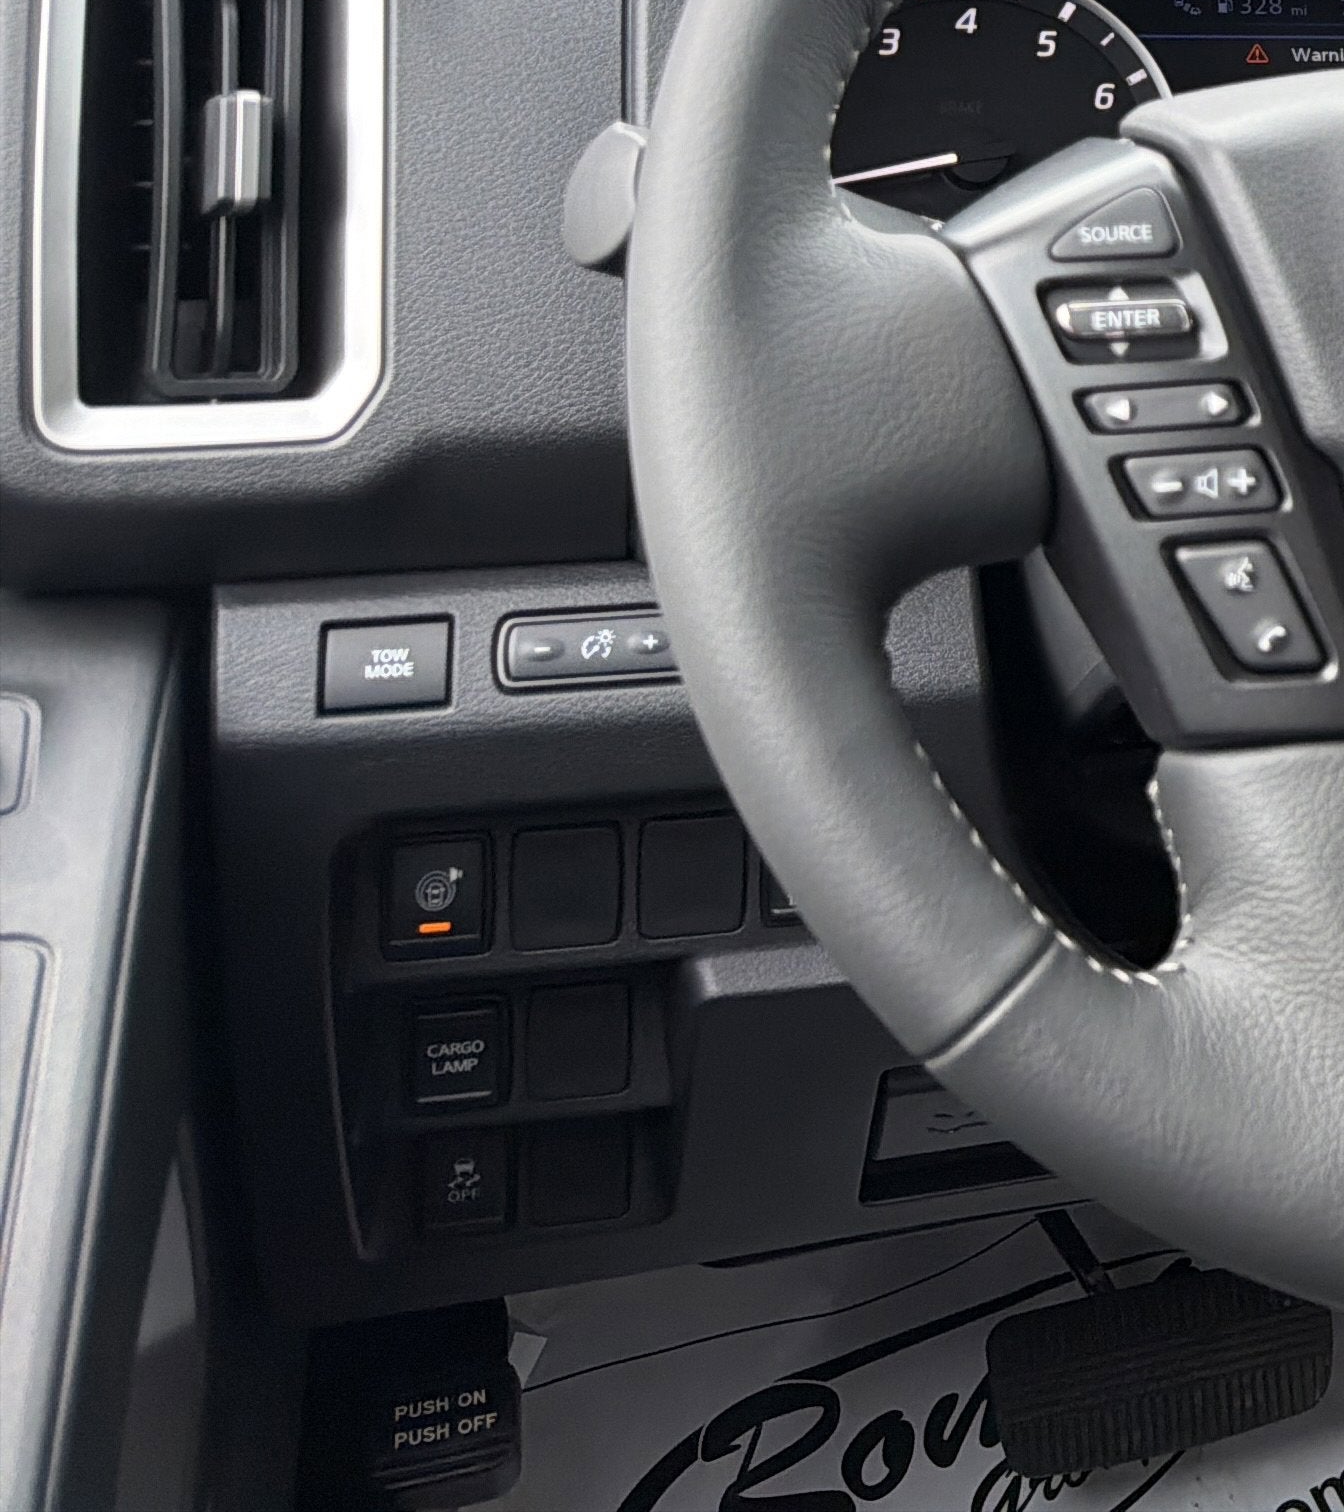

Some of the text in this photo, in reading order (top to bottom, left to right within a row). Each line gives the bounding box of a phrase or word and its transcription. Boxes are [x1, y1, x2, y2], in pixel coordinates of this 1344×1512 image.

[955, 7, 978, 35] 4
[1291, 5, 1308, 16] mi
[879, 28, 901, 56] 3
[1036, 30, 1058, 57] 5
[1094, 83, 1116, 110] 6
[1078, 224, 1153, 243] SOURCE
[1094, 307, 1161, 329] ENTER
[371, 648, 410, 663] TOW
[364, 661, 415, 679] MODE
[427, 1040, 485, 1058] CARGO
[431, 1057, 479, 1076] LAMP
[394, 1389, 487, 1422] PUSH ON
[394, 1412, 498, 1450] PUSH OFF
